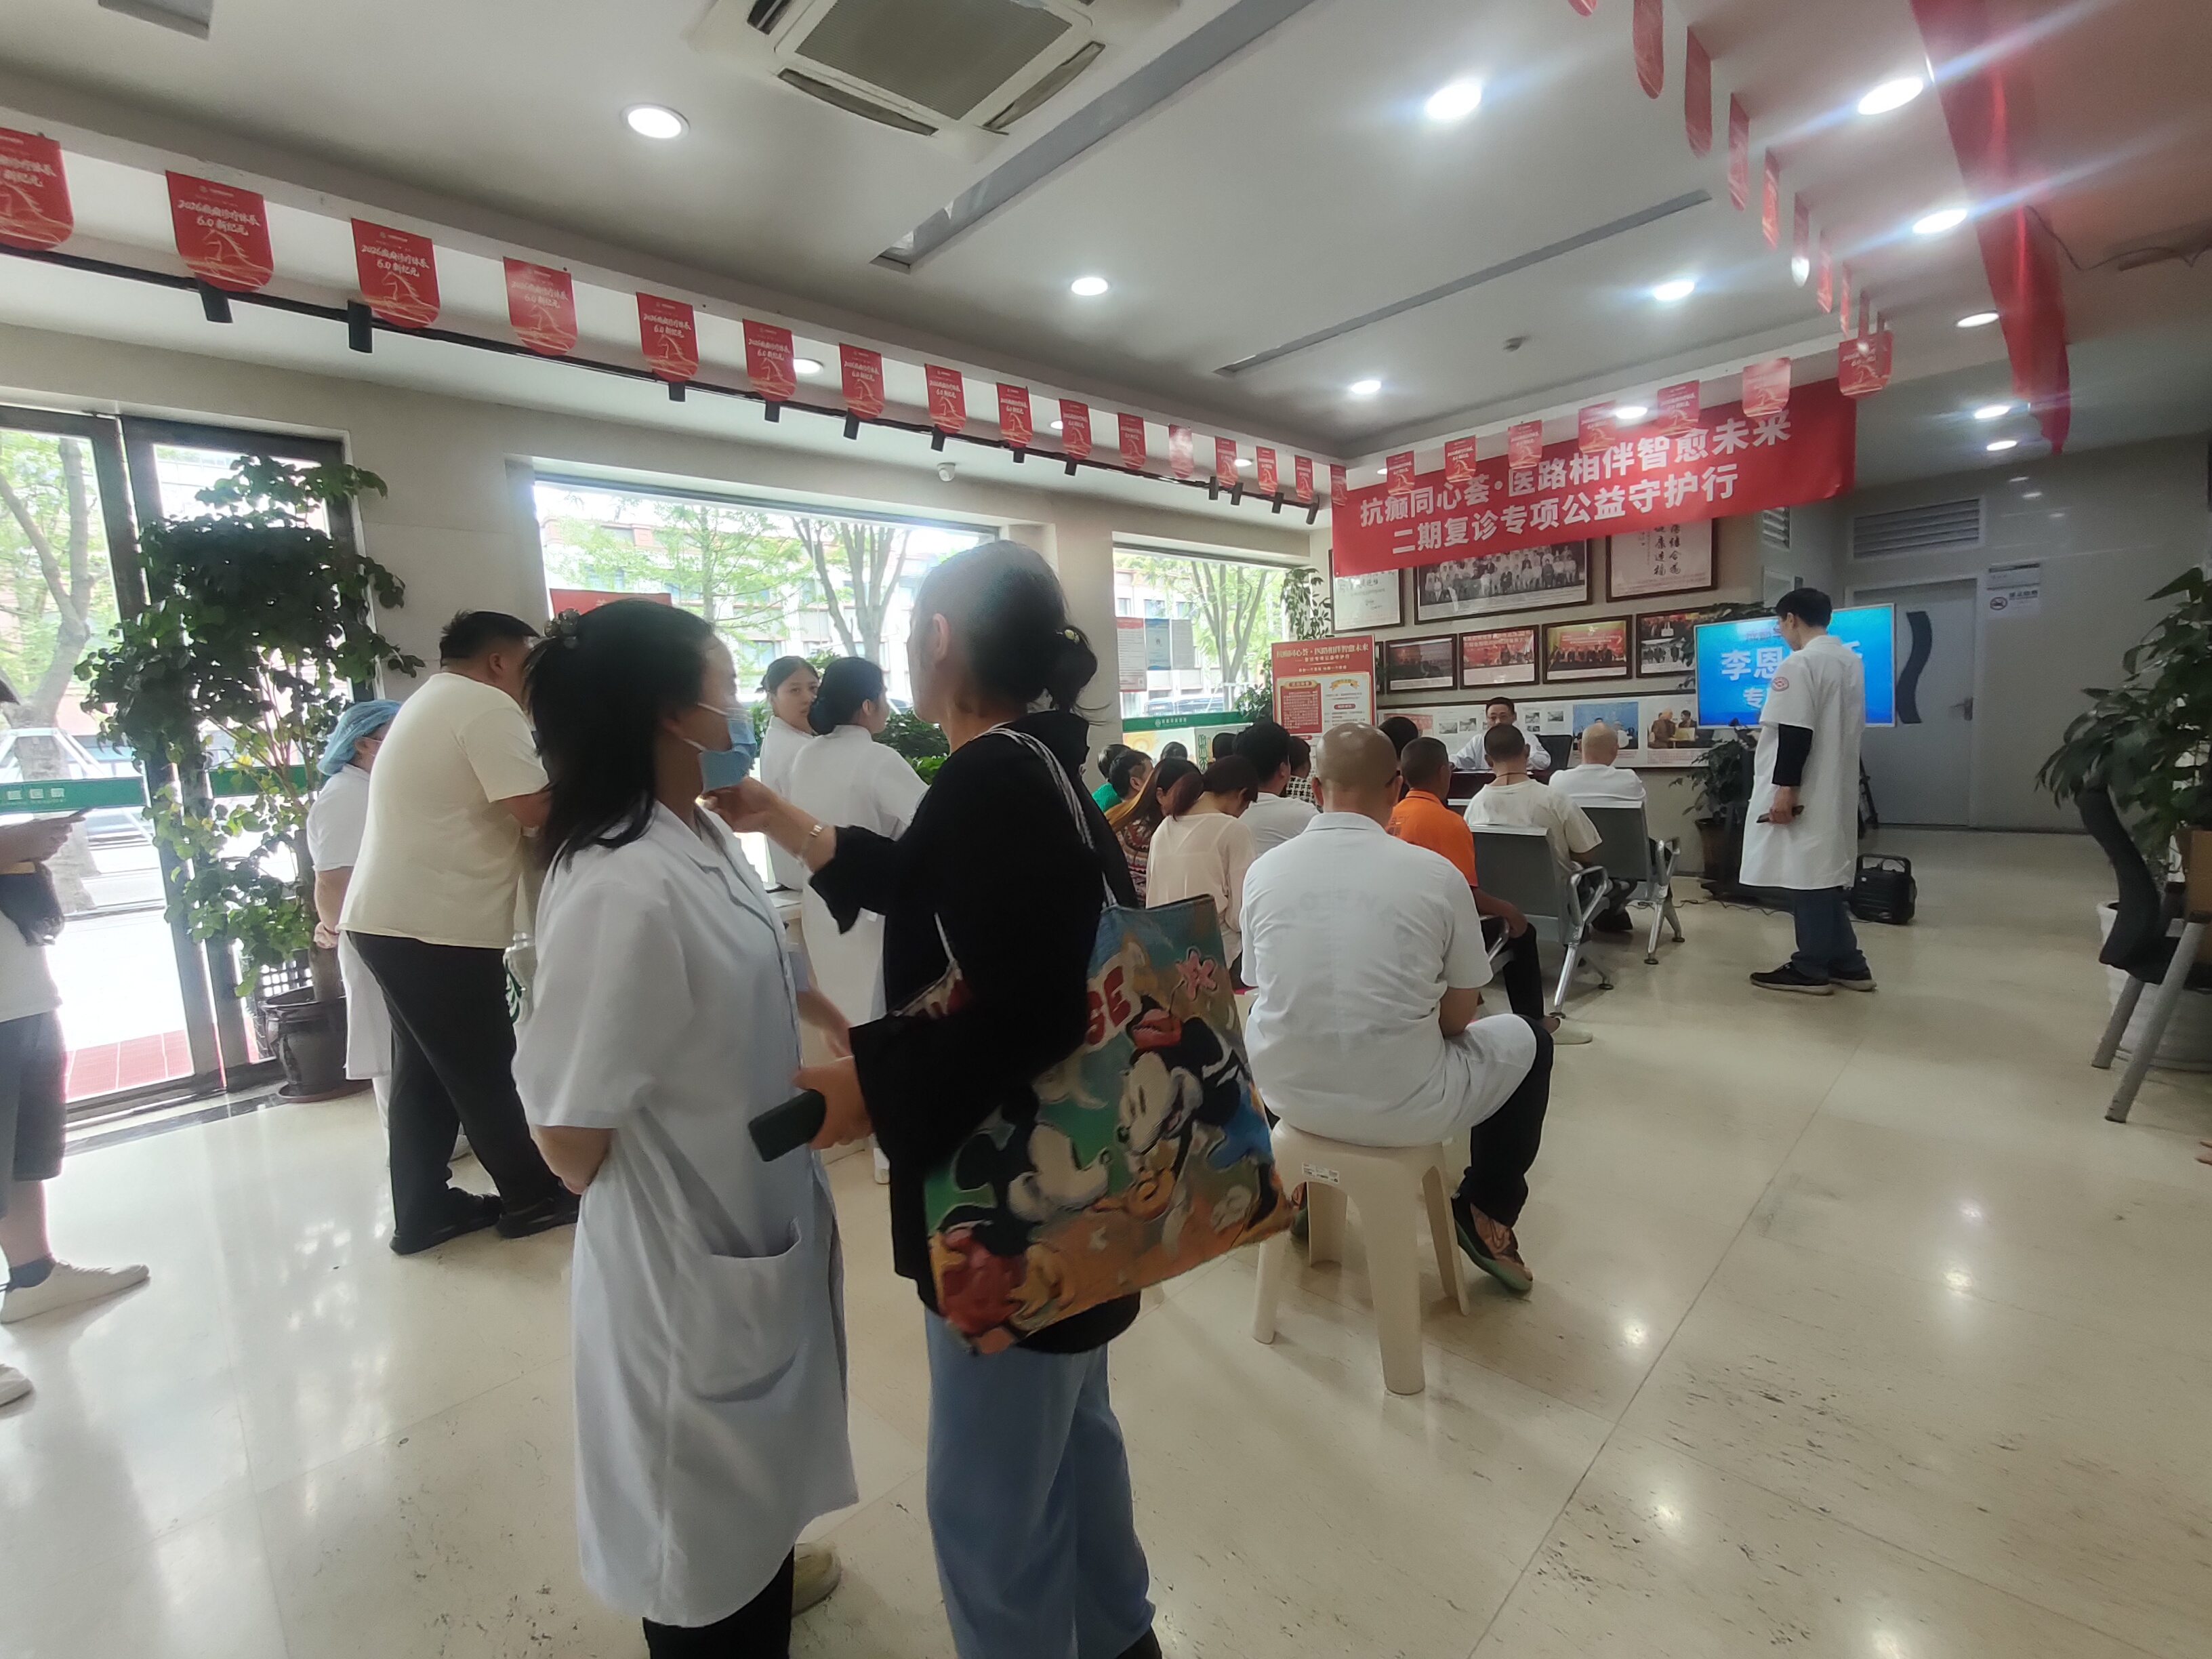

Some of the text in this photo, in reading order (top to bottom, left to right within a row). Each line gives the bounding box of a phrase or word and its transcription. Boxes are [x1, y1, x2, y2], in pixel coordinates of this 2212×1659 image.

[1393, 463, 1739, 554] 二期复诊专项公益守护行
